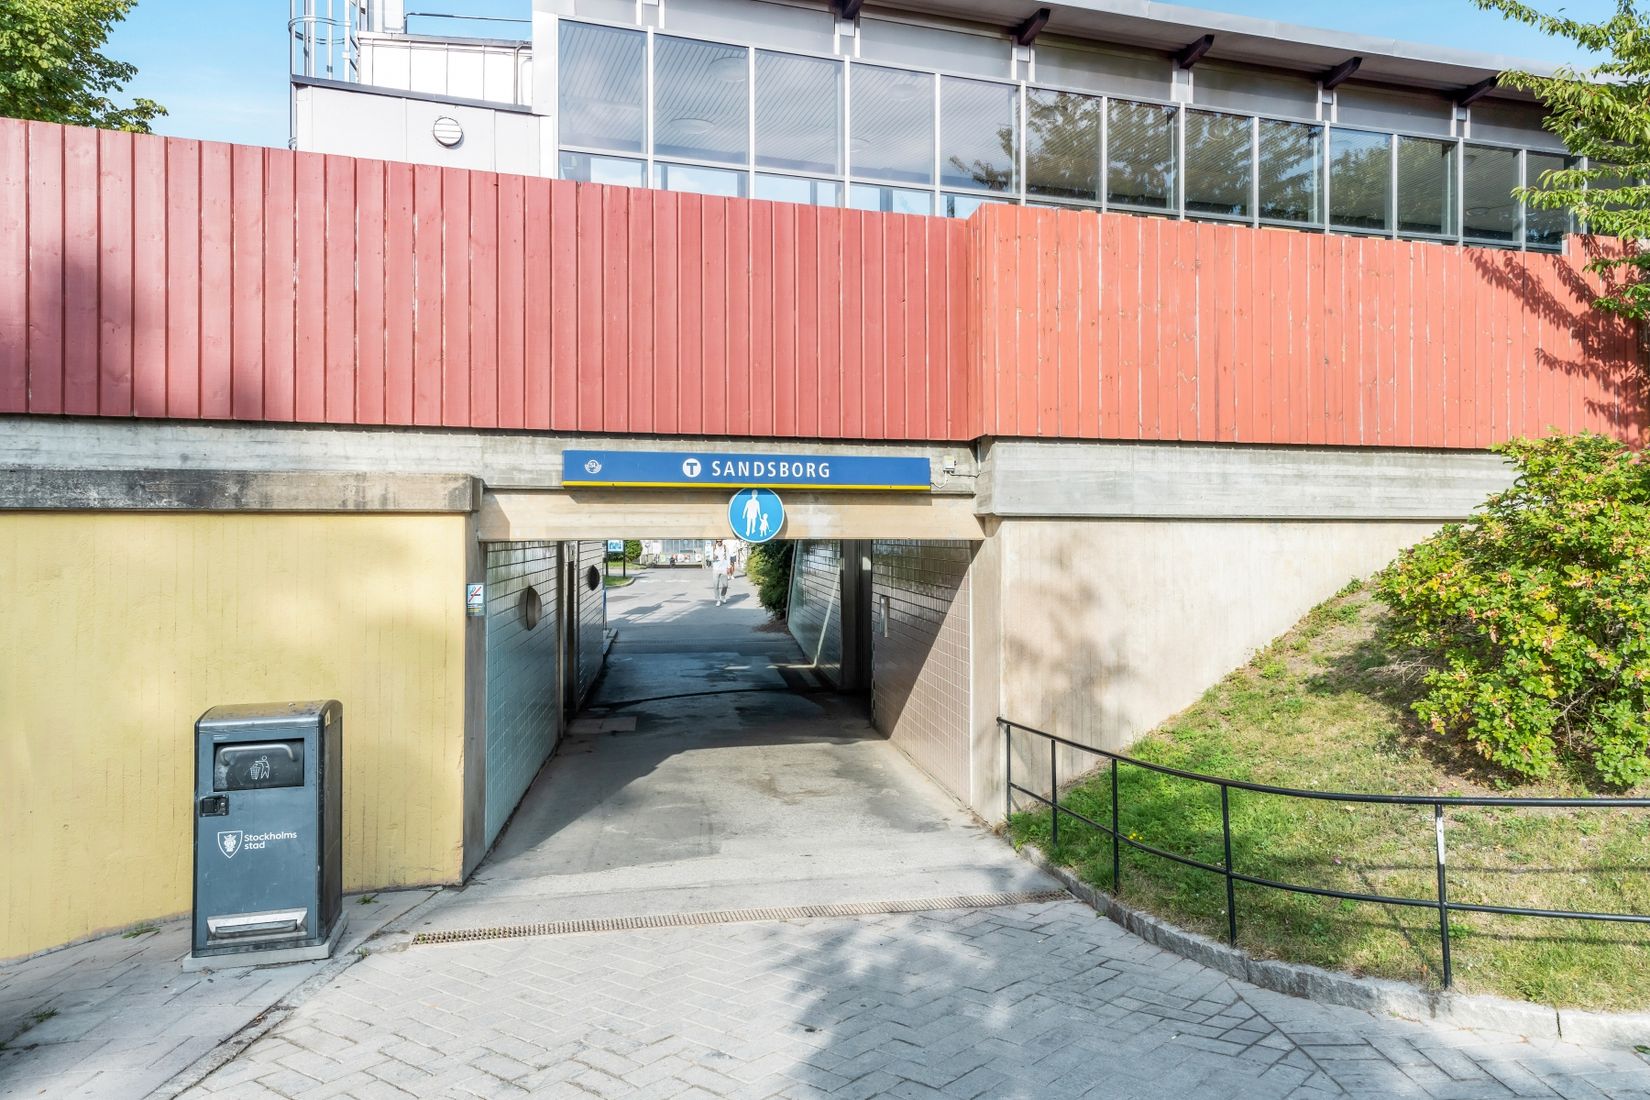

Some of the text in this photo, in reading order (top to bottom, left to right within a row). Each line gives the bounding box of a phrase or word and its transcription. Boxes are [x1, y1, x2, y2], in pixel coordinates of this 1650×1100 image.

[711, 460, 830, 478] SANDSBORG
[244, 831, 298, 842] Stockholms
[244, 841, 266, 850] stad
